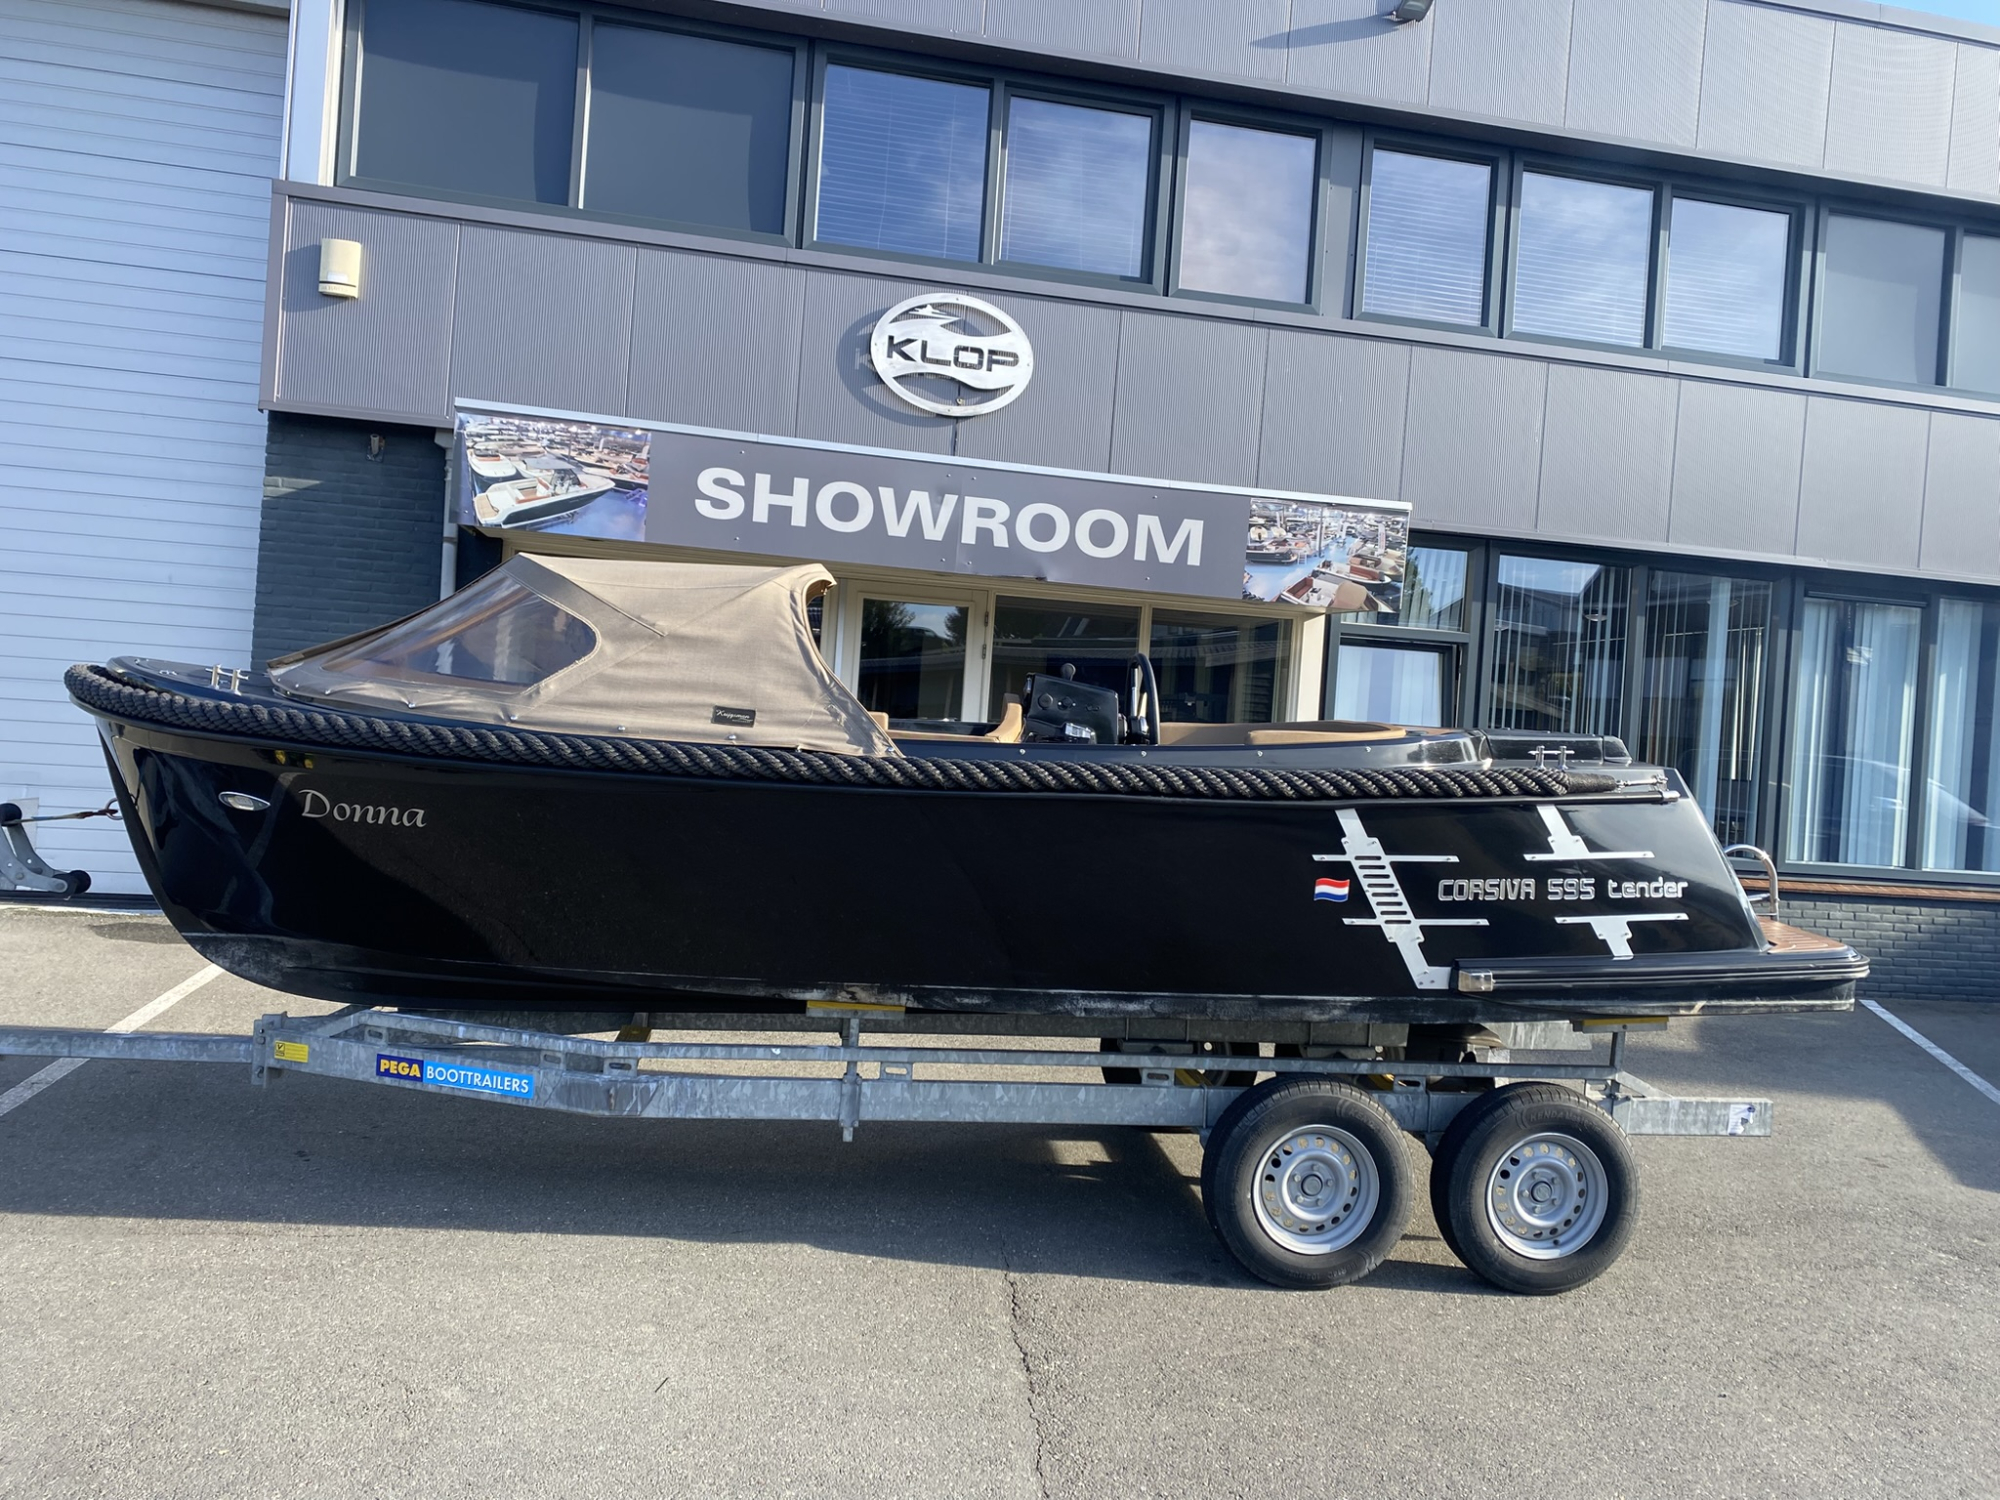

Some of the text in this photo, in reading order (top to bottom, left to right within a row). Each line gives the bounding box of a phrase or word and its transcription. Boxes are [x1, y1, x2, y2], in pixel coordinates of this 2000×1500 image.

[886, 334, 1020, 373] KLOP
[694, 466, 1205, 567] SHOWROOM
[298, 788, 428, 829] Donna
[1437, 875, 1689, 901] CORSIVA 595 tender
[379, 1058, 530, 1094] PEGA BOOTTRAILERS
